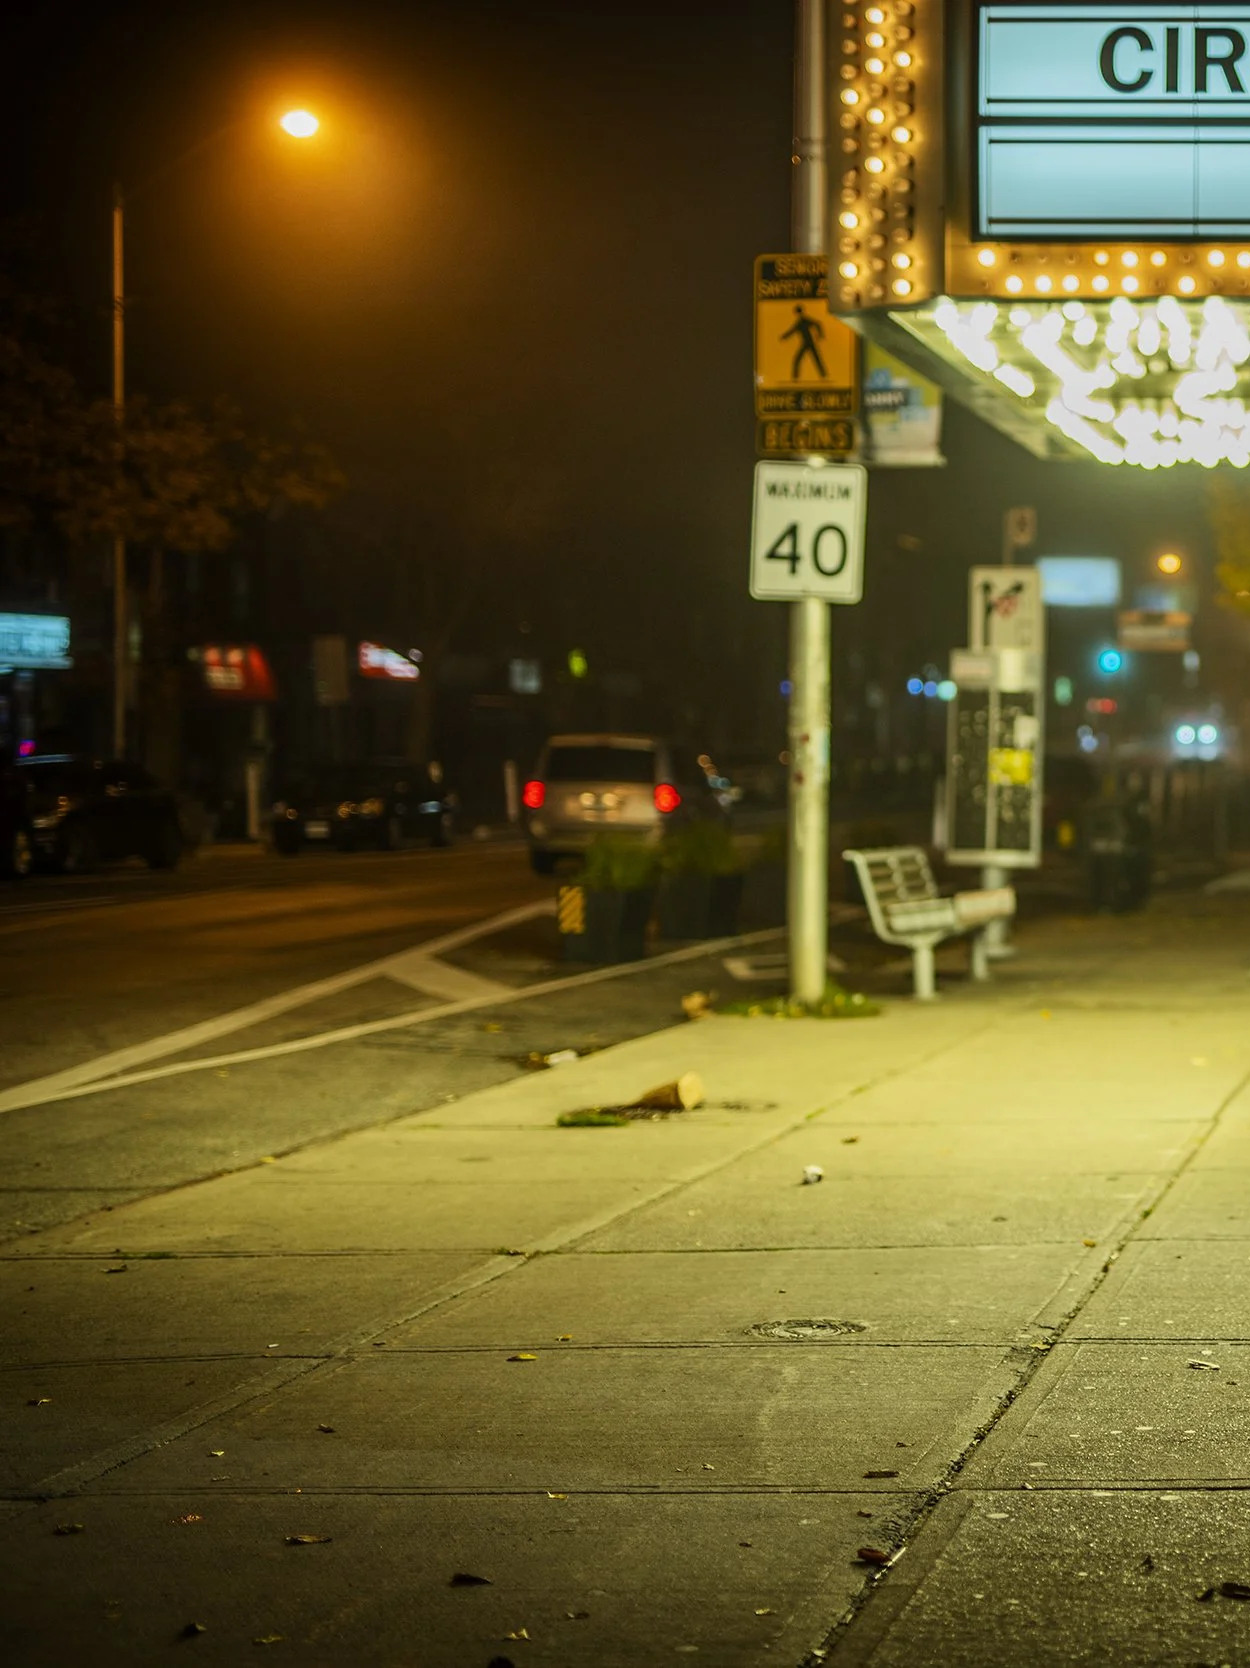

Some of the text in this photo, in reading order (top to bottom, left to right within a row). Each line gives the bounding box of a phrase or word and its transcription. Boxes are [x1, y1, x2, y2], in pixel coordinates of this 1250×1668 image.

[765, 421, 849, 448] BEGINS
[765, 482, 851, 500] MAXIMUM
[764, 522, 848, 577] 40
